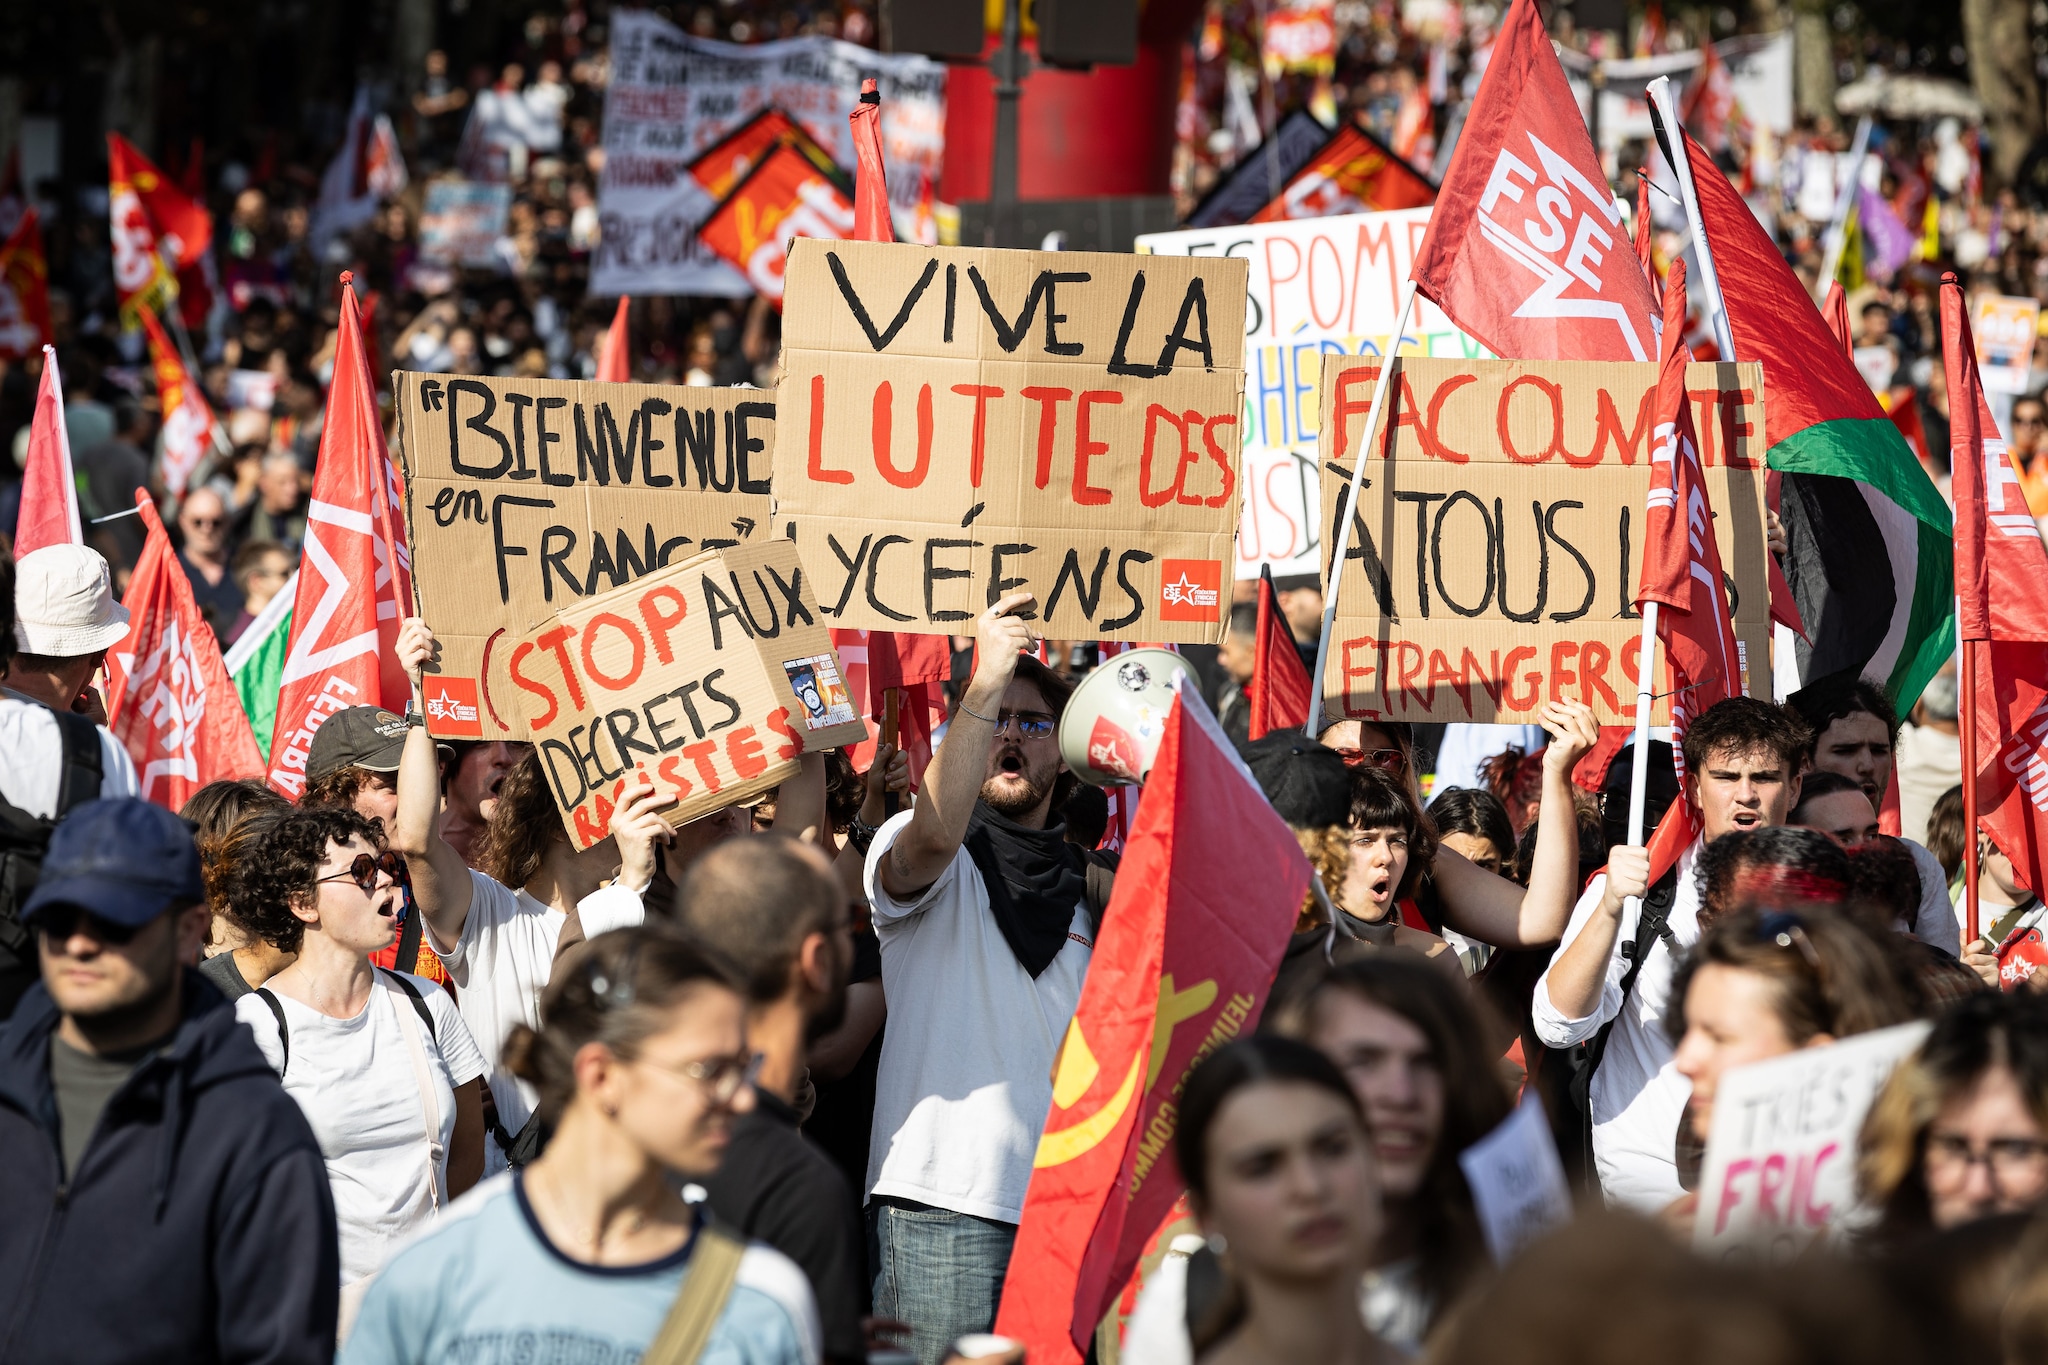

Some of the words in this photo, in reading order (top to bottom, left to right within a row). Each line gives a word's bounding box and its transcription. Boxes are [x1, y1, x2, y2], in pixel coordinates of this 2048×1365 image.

[1478, 147, 1613, 293] FSE
[825, 251, 1091, 355] VIVE
[1107, 270, 1216, 378] LA
[807, 374, 1124, 506] LUTTE
[1139, 403, 1237, 509] DES
[1333, 366, 1477, 464] FAC
[426, 487, 488, 527] en
[1392, 490, 1596, 624] TOUS
[509, 585, 688, 731] STOP
[701, 564, 814, 650] AUX
[540, 668, 742, 813] DECRETS
[1713, 1141, 1840, 1237] FRIC
